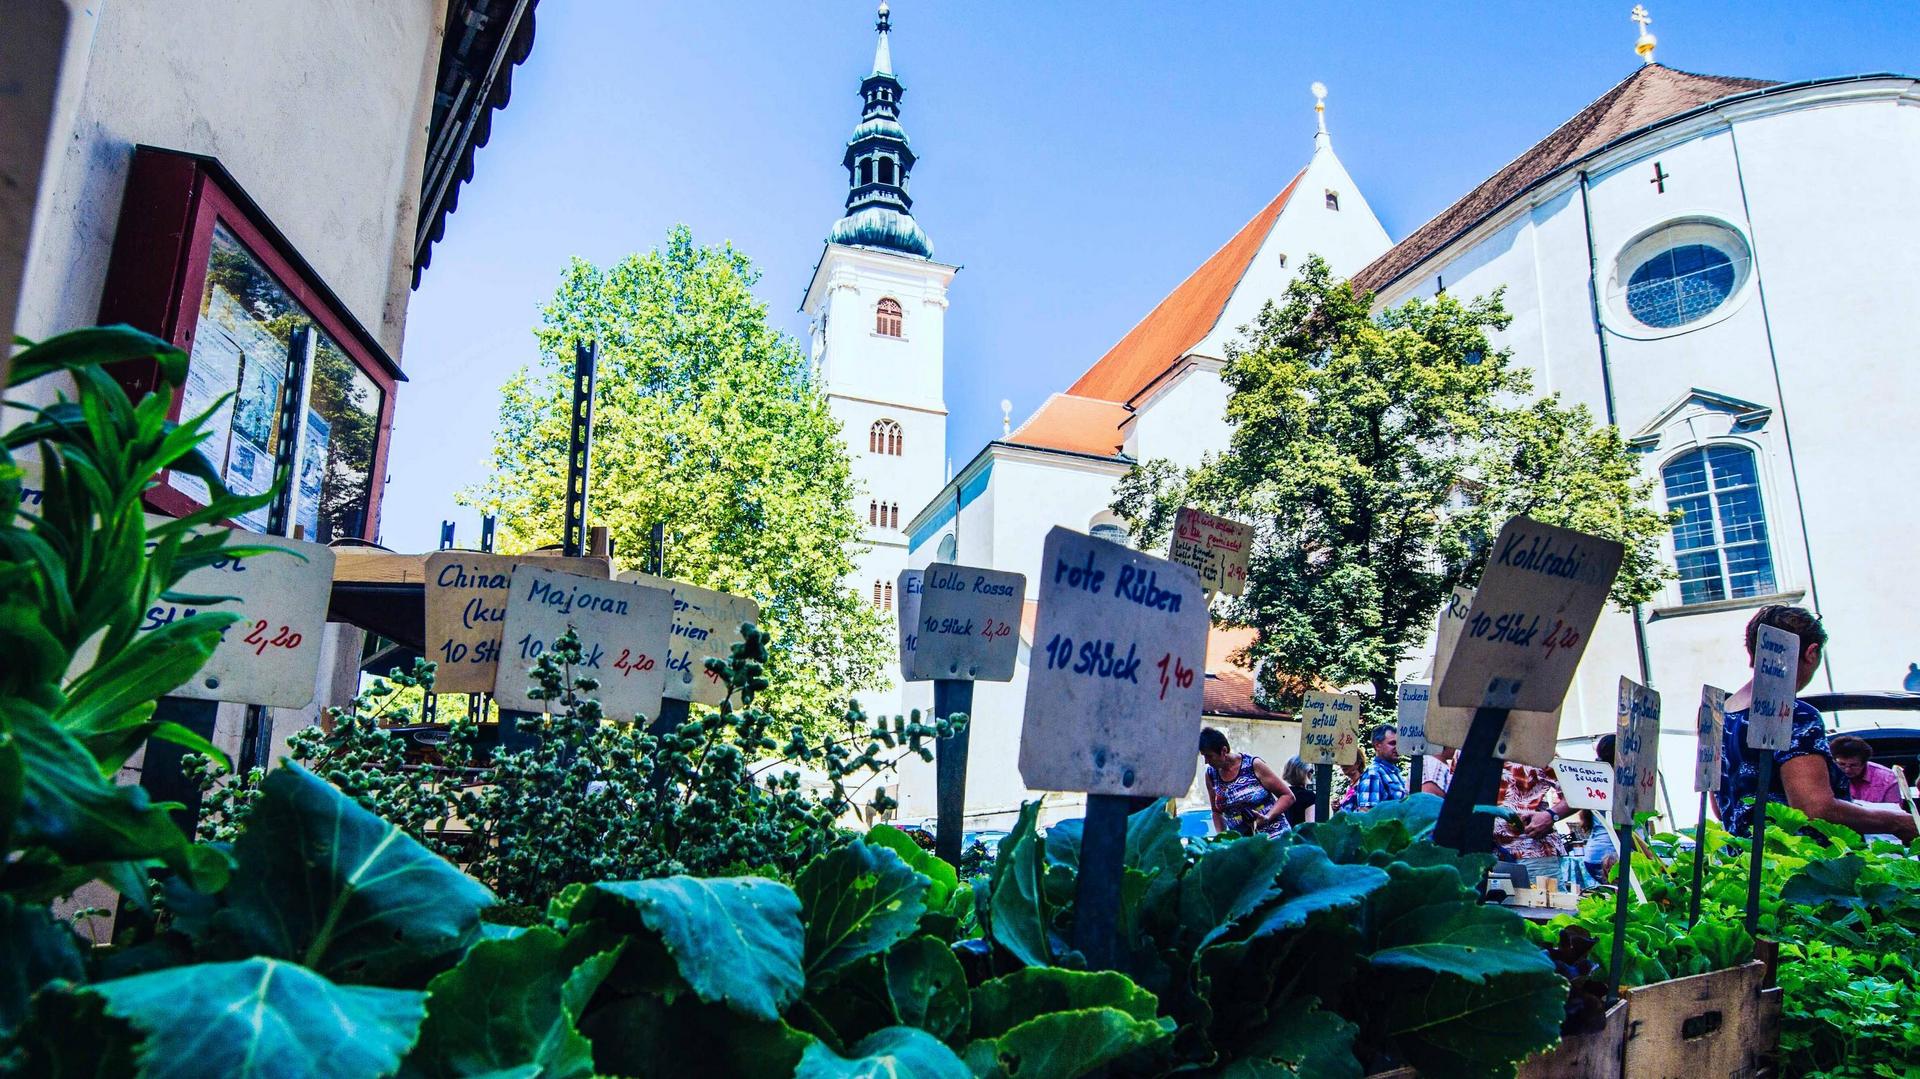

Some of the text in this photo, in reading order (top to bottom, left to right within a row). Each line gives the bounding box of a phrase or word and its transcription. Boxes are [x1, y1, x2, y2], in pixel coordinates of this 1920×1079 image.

[1498, 532, 1586, 579] Kohlrabi
[527, 580, 629, 616] Majoran
[930, 570, 1014, 597] Lollo Rossa
[1054, 552, 1182, 613] rote Rüben
[244, 619, 302, 656] 2,20
[924, 616, 1011, 642] 10 Stück 2,20
[1469, 611, 1580, 660] 10 Stück 2,20
[441, 638, 466, 664] 10
[519, 634, 543, 659] 10
[614, 649, 655, 676] 2,20
[1046, 634, 1193, 700] 10 Stück 1,40
[1312, 713, 1338, 728] gefüllt
[1400, 726, 1408, 737] 10
[1306, 732, 1314, 744] 10
[1314, 733, 1334, 746] Stück
